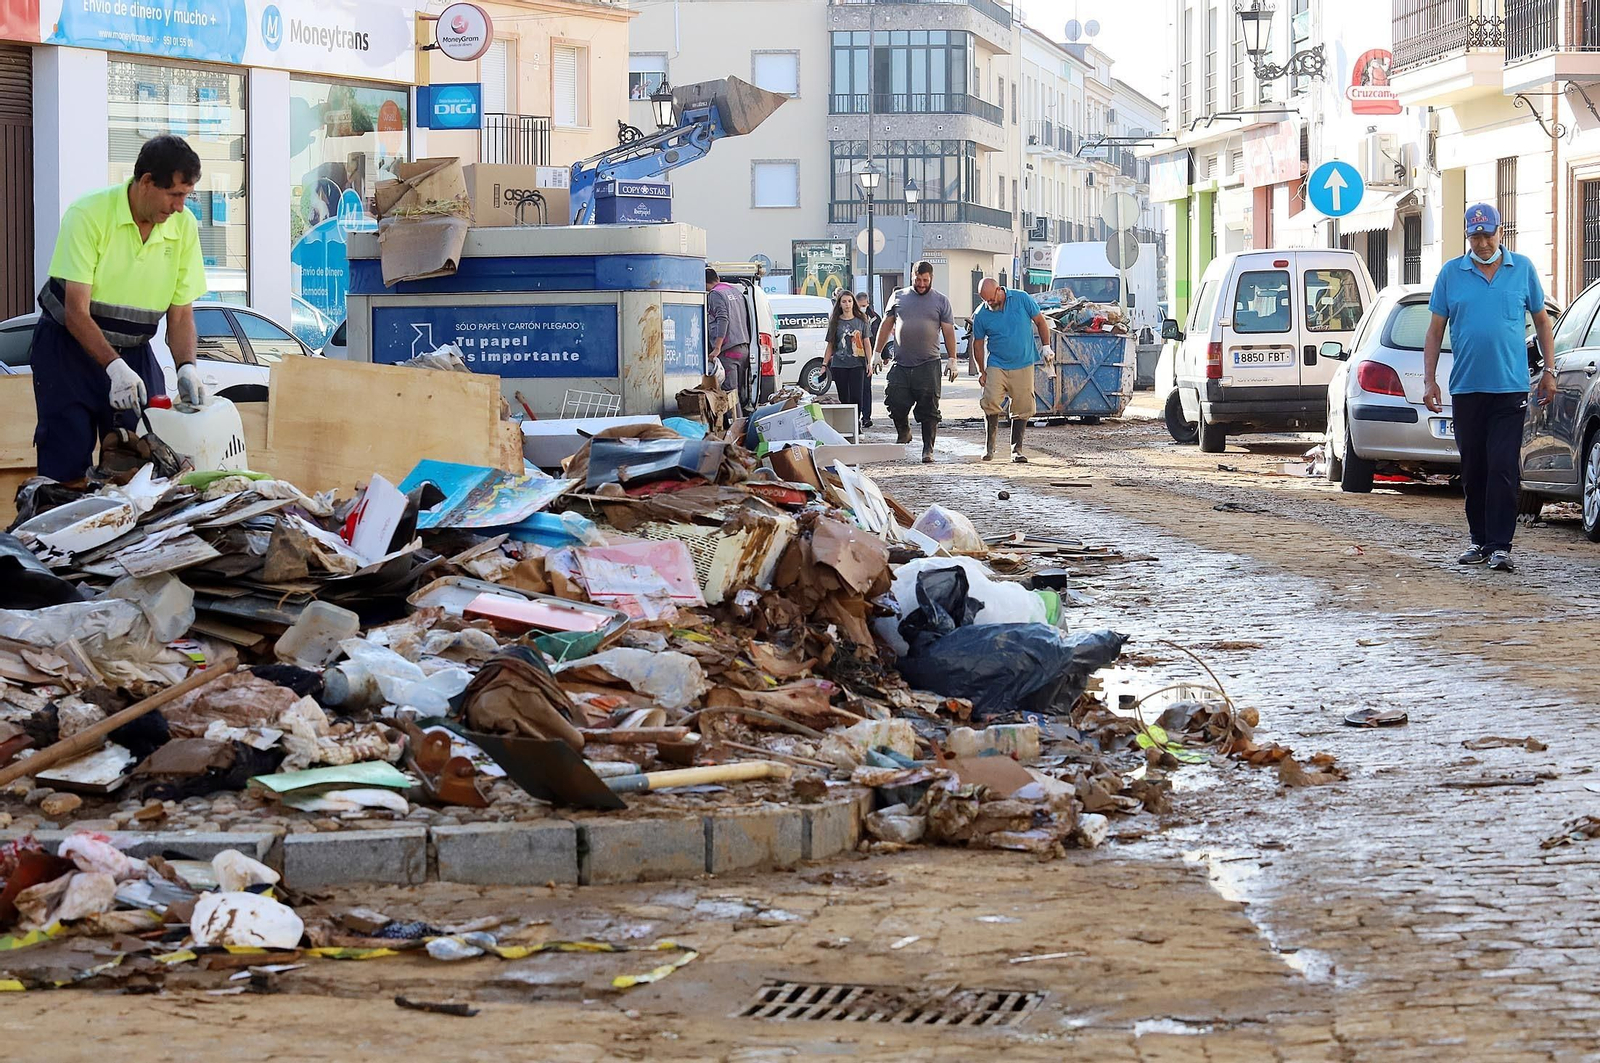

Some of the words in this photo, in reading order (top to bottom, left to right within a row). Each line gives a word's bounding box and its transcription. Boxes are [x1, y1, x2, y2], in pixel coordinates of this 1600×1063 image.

[113, 2, 127, 16] de
[130, 2, 163, 20] dinero
[164, 9, 171, 26] y
[173, 9, 208, 26] mucho
[290, 19, 369, 52] Moneytrans
[1352, 89, 1399, 99] Cruzcamp
[434, 104, 477, 115] DIGI
[622, 185, 641, 194] COPY
[649, 187, 667, 196] STAR
[455, 322, 476, 331] SÓLO
[479, 323, 500, 331] PAPEL
[501, 323, 507, 331] Y
[508, 322, 541, 330] CARTÓN
[543, 322, 580, 330] PLEGADO
[456, 337, 475, 347] Tu
[480, 336, 528, 349] papel
[481, 351, 580, 364] importante
[1241, 353, 1265, 363] 8850
[1268, 352, 1285, 362] FBT
